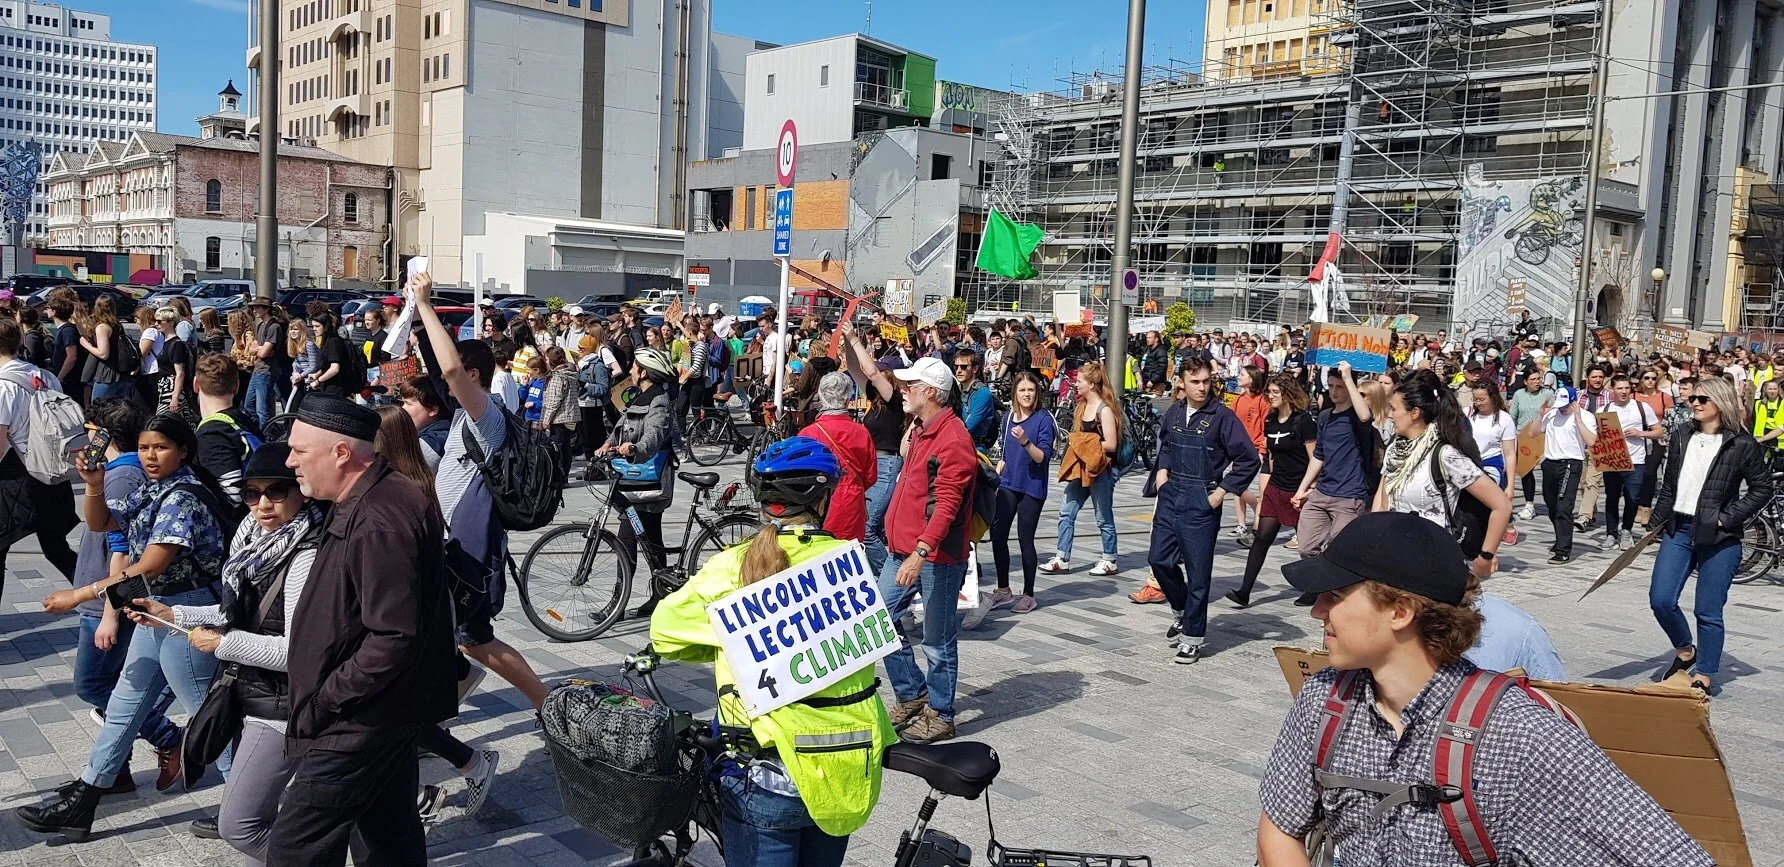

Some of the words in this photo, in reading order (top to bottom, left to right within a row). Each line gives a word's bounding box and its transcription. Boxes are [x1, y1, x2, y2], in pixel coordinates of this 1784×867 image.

[782, 141, 791, 166] 10
[776, 230, 789, 240] SHARED
[777, 241, 787, 251] ZONE
[1660, 341, 1675, 350] WILL
[1609, 459, 1632, 470] THIS
[718, 569, 819, 634] LINCOLN
[822, 549, 864, 586] UNI
[744, 580, 877, 663] LECTURERS
[757, 668, 779, 699] 4
[789, 608, 896, 685] CLIMATE
